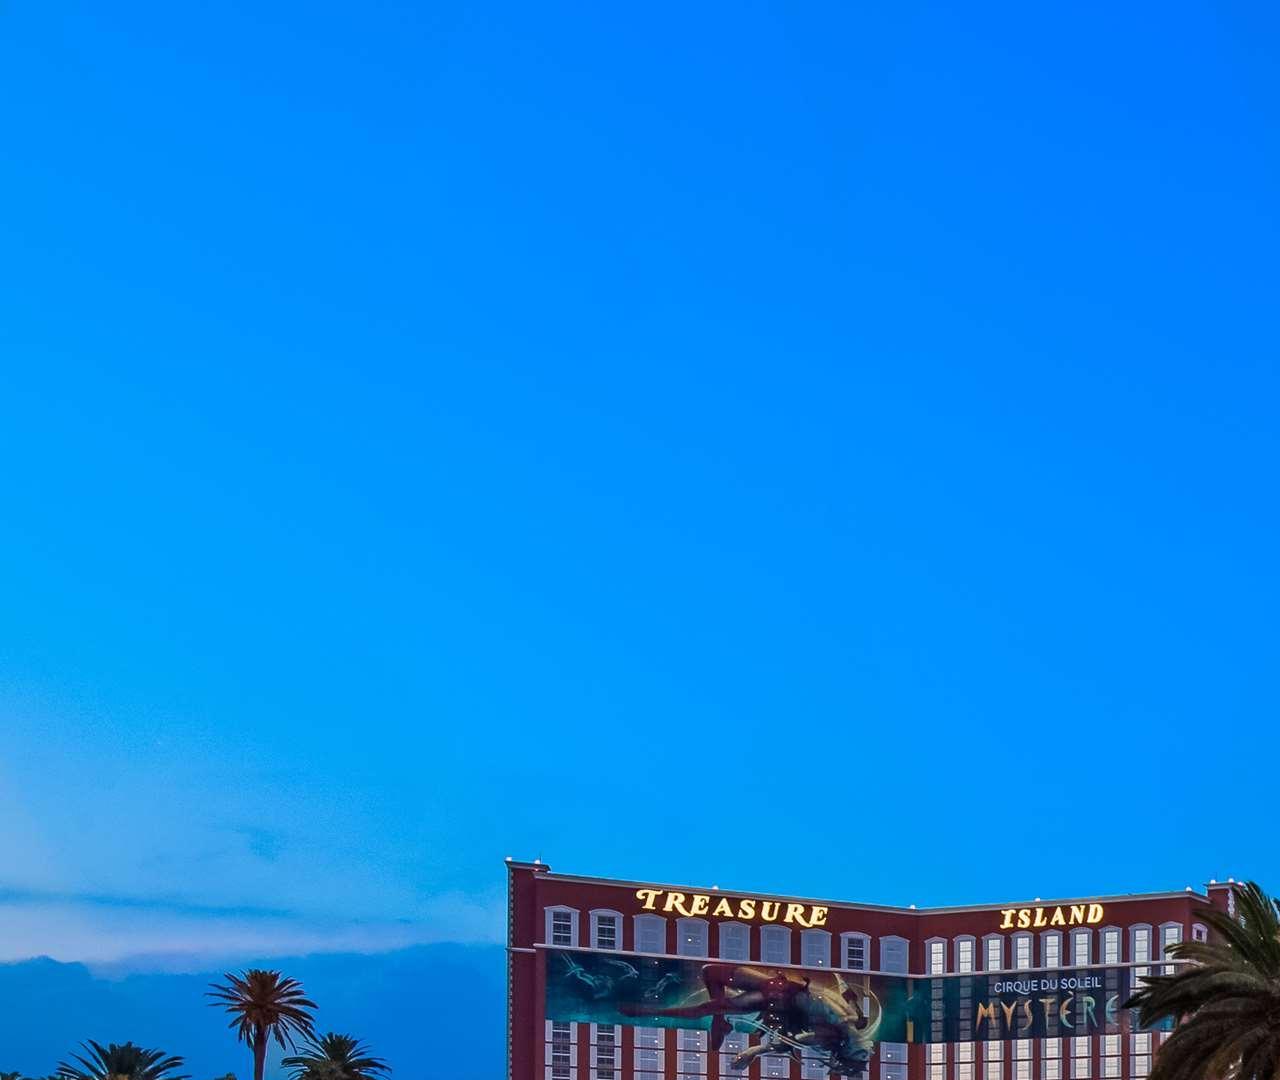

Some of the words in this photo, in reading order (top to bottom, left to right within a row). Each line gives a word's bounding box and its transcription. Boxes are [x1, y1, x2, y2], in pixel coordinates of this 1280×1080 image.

[636, 889, 829, 928] TREASURE
[1000, 903, 1104, 929] ISLAND
[994, 979, 1039, 995] CIRQUE
[1040, 977, 1059, 990] DU
[1060, 975, 1102, 990] SOLEIL
[975, 990, 1120, 1032] MYSTÈRE
